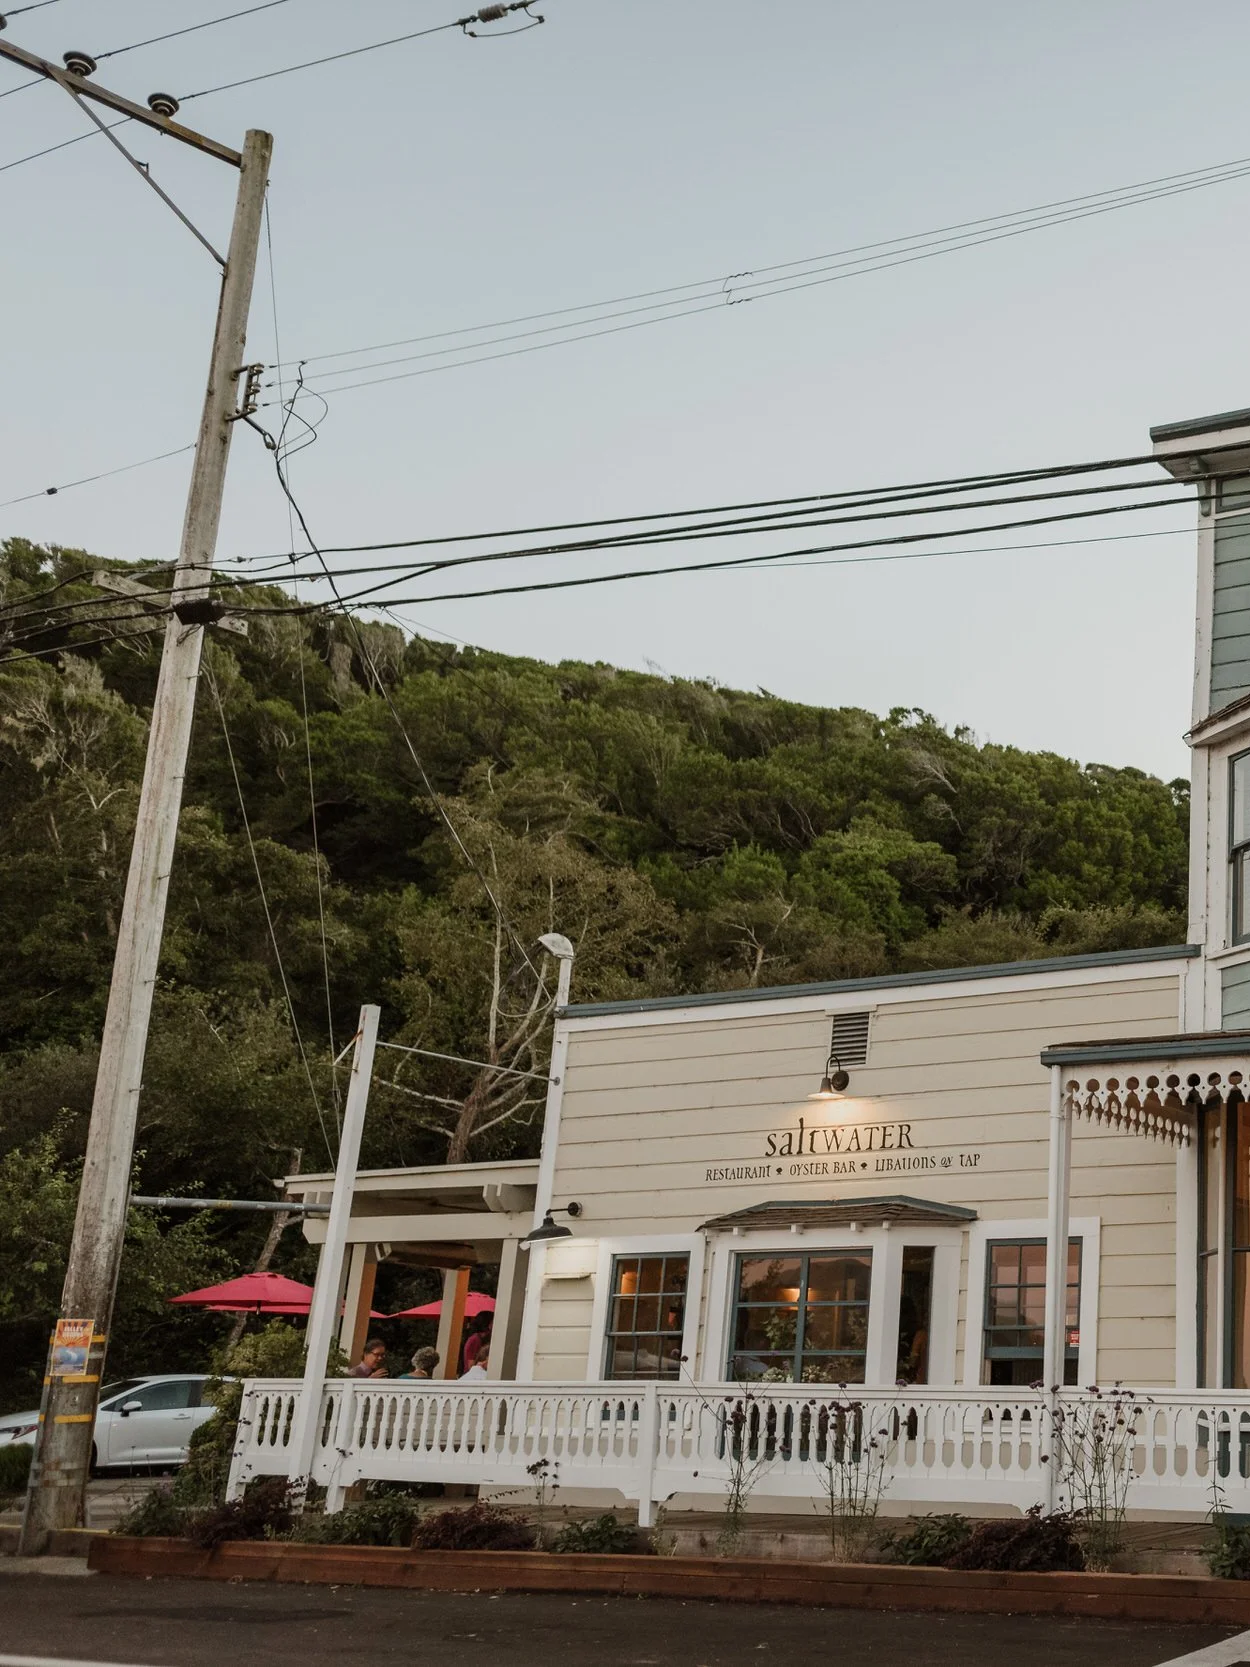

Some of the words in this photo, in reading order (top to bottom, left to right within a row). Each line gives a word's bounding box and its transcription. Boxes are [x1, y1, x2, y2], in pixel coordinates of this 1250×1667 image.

[789, 1161, 829, 1176] OYSTER
[833, 1160, 857, 1174] BAR
[959, 1153, 981, 1167] TAP
